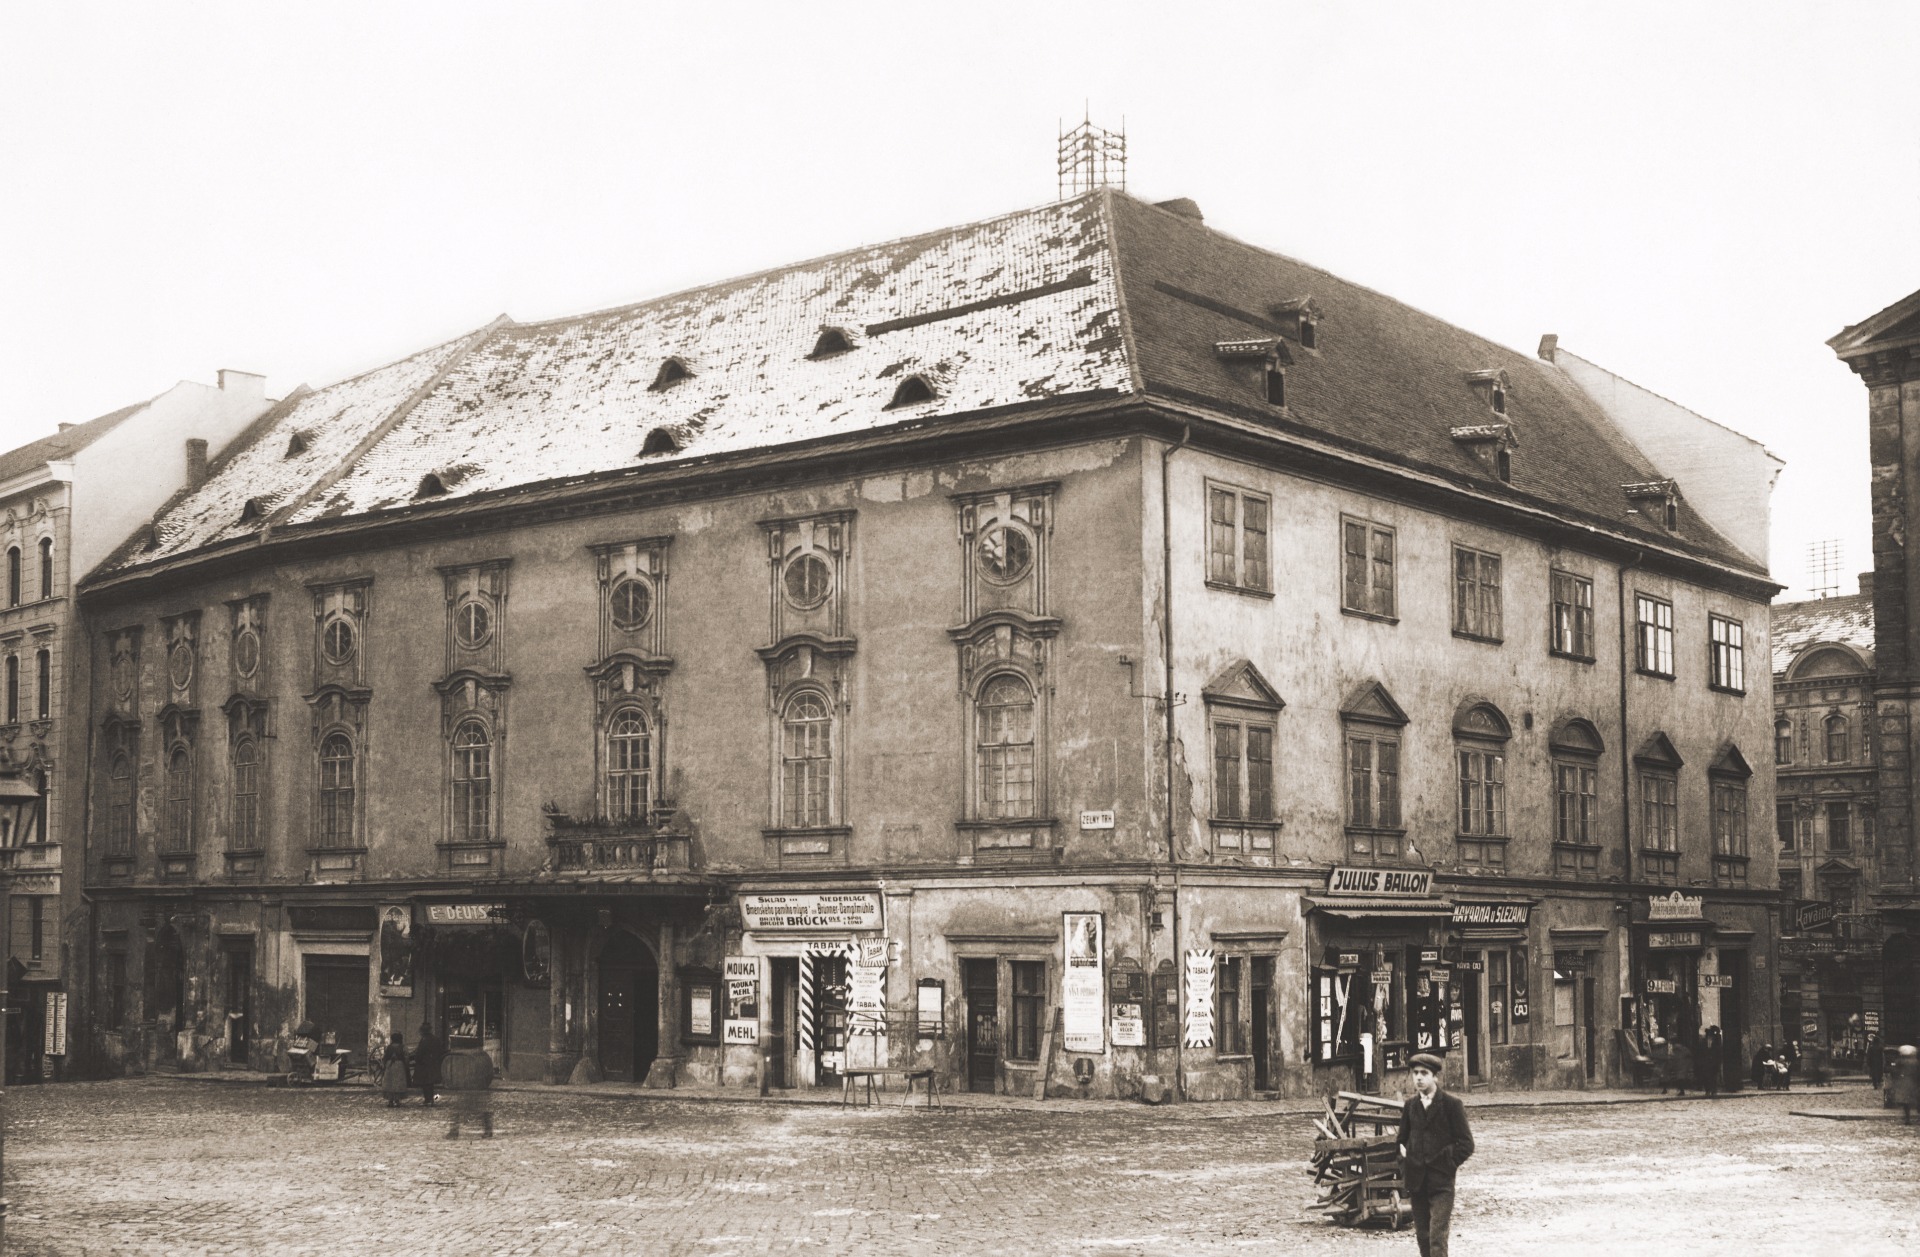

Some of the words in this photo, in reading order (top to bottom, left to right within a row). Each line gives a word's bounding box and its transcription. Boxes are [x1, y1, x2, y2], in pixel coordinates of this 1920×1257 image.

[1384, 872, 1429, 893] BALLON
[726, 962, 756, 975] MOUKA
[731, 980, 753, 989] MOUKA
[733, 988, 751, 996] MEHL
[728, 1026, 756, 1039] MEHL
